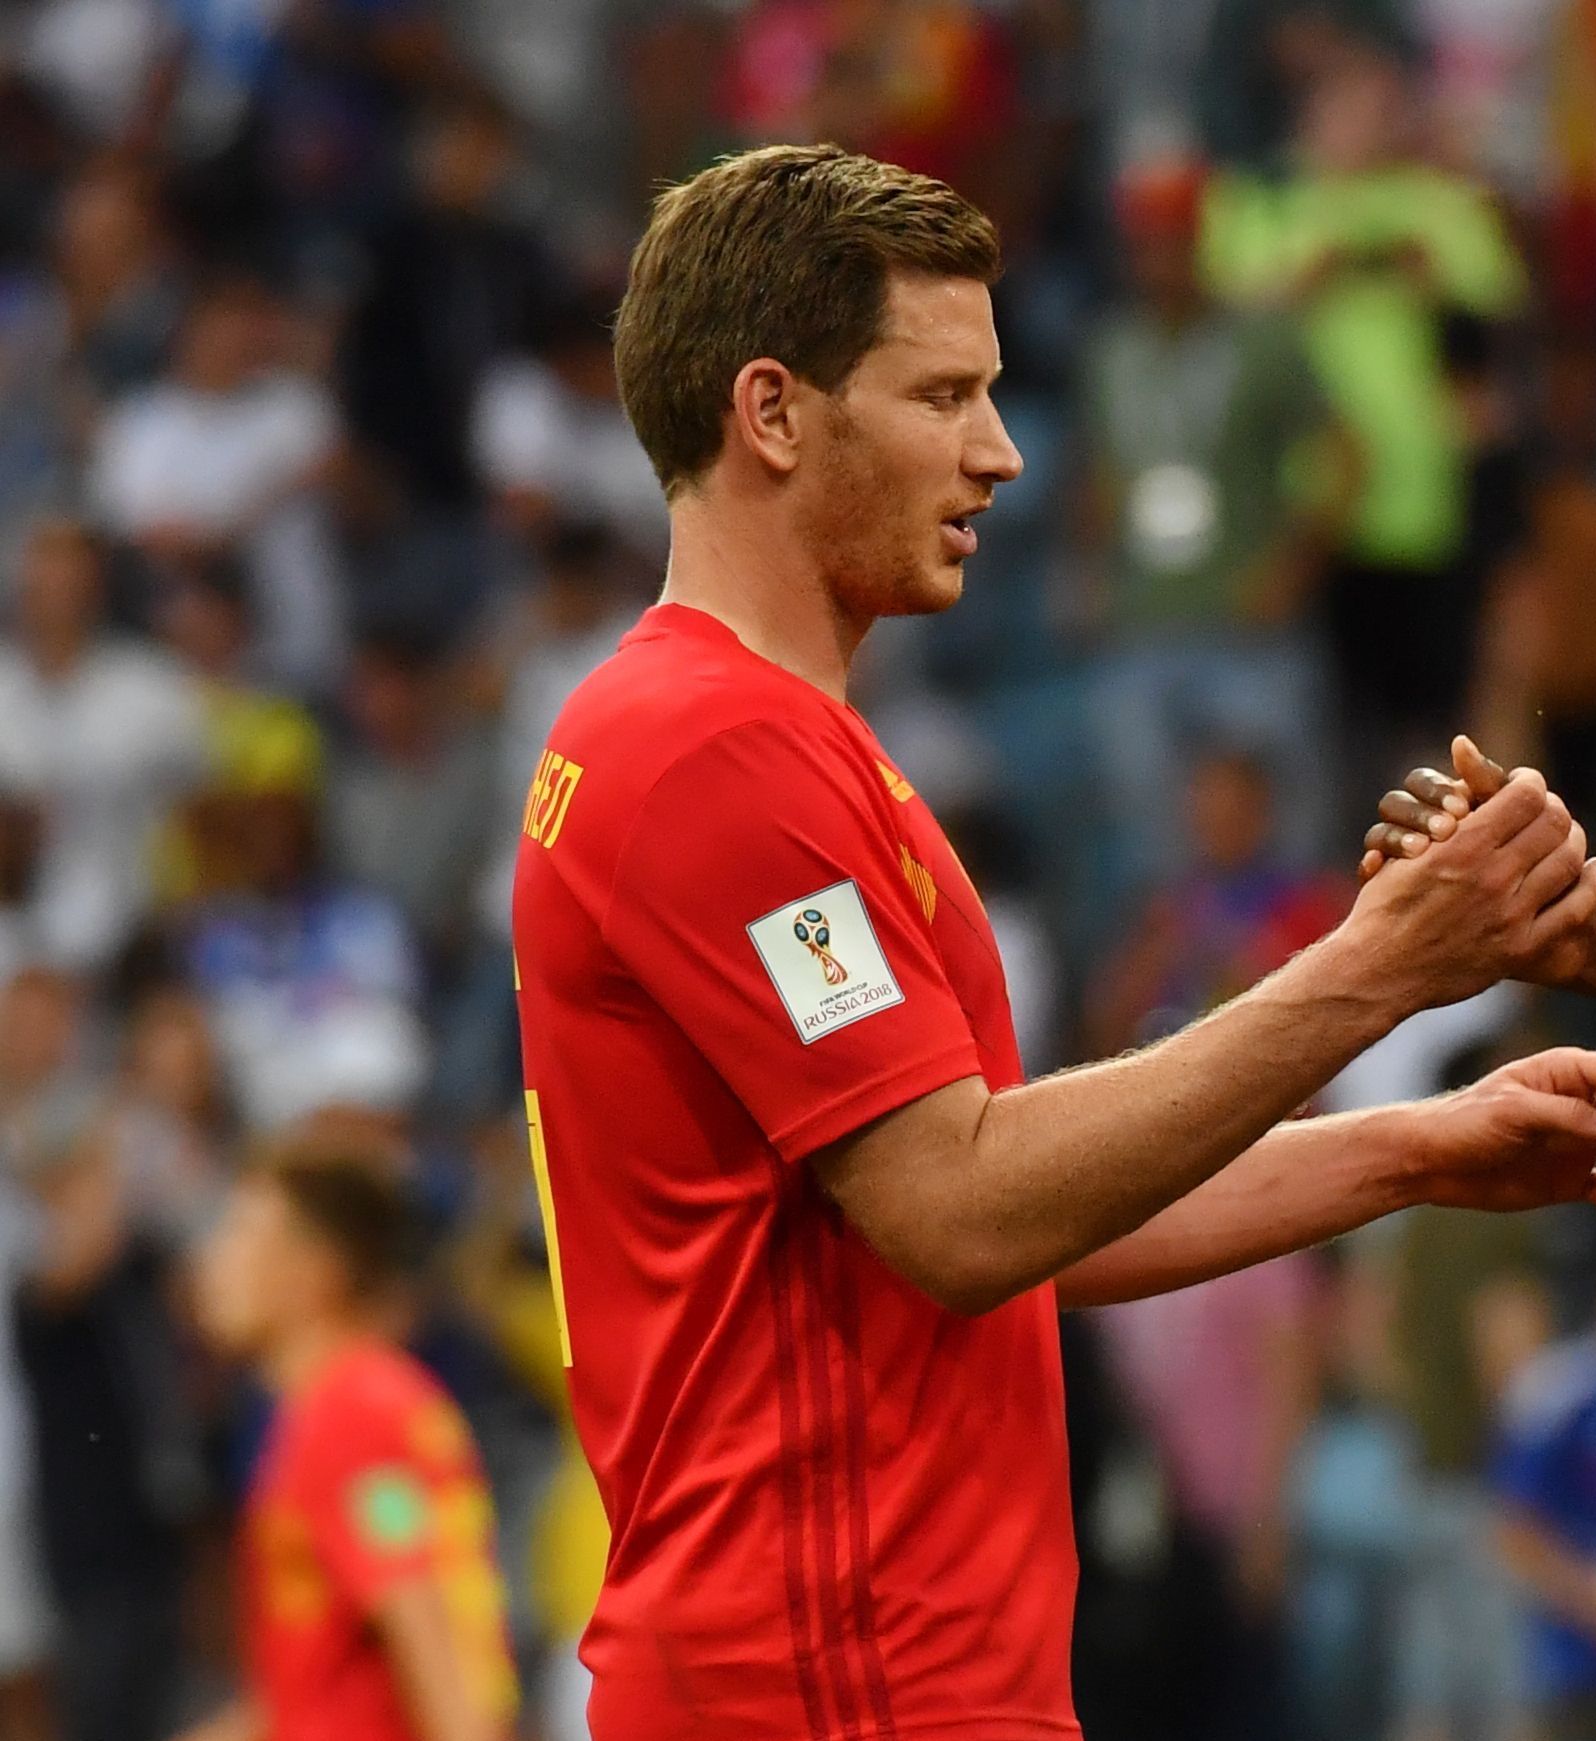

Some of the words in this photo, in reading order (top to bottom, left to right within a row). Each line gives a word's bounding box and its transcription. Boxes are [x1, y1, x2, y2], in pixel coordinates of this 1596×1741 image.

[803, 996, 861, 1030] RUSSIA
[860, 983, 892, 1005] 2018
[834, 986, 857, 999] WORLD
[856, 982, 868, 991] CUP
